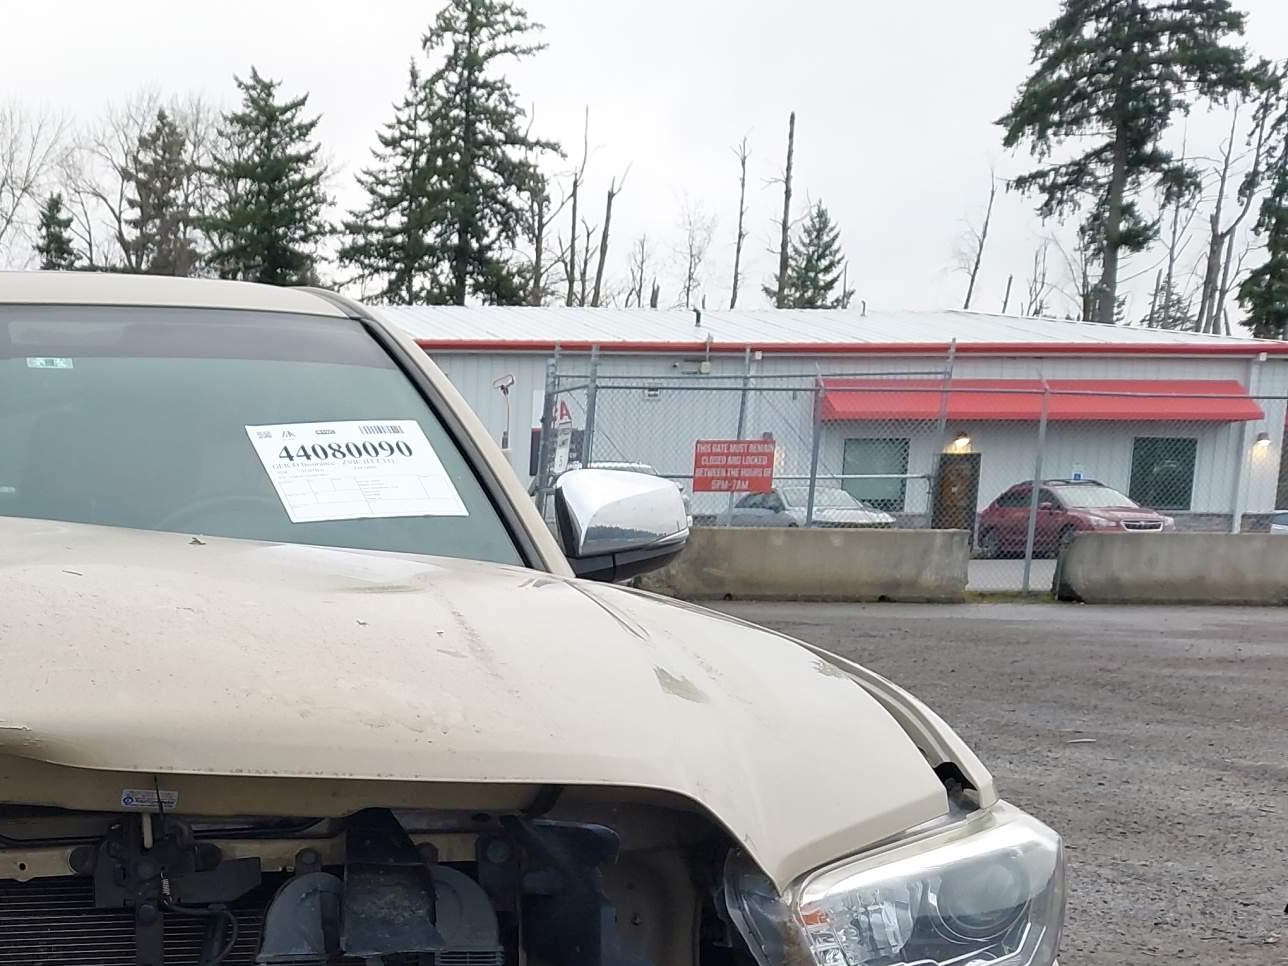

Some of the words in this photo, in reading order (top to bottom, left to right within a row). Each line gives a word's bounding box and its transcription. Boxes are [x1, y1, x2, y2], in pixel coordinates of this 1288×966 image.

[279, 440, 413, 461] 44080090
[697, 444, 711, 453] THIS
[712, 444, 728, 453] GATE
[729, 444, 747, 453] MUST
[727, 455, 741, 465] AND
[743, 455, 768, 465] LOCKED
[695, 467, 726, 477] BETWEEN
[727, 467, 740, 477] THE
